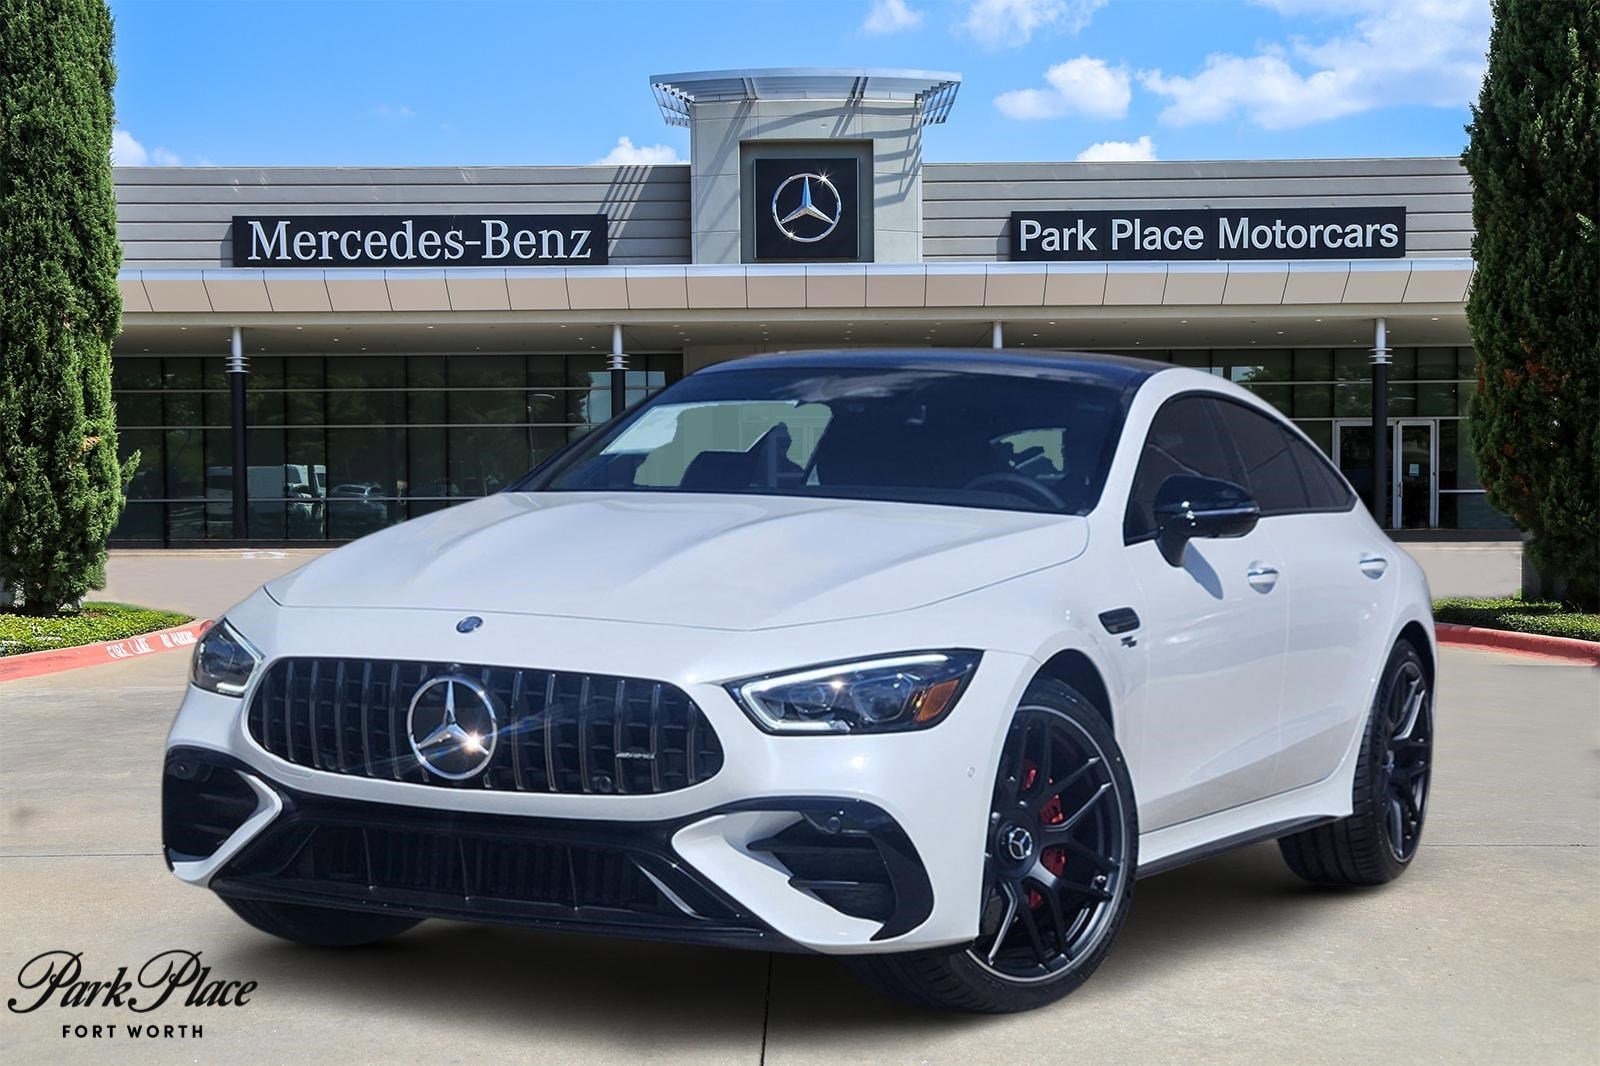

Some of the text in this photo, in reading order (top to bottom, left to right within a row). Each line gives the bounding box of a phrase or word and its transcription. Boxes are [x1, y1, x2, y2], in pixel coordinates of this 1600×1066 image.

[247, 219, 592, 261] Mercedes-Benz
[1019, 216, 1399, 252] Park Place Motorcars
